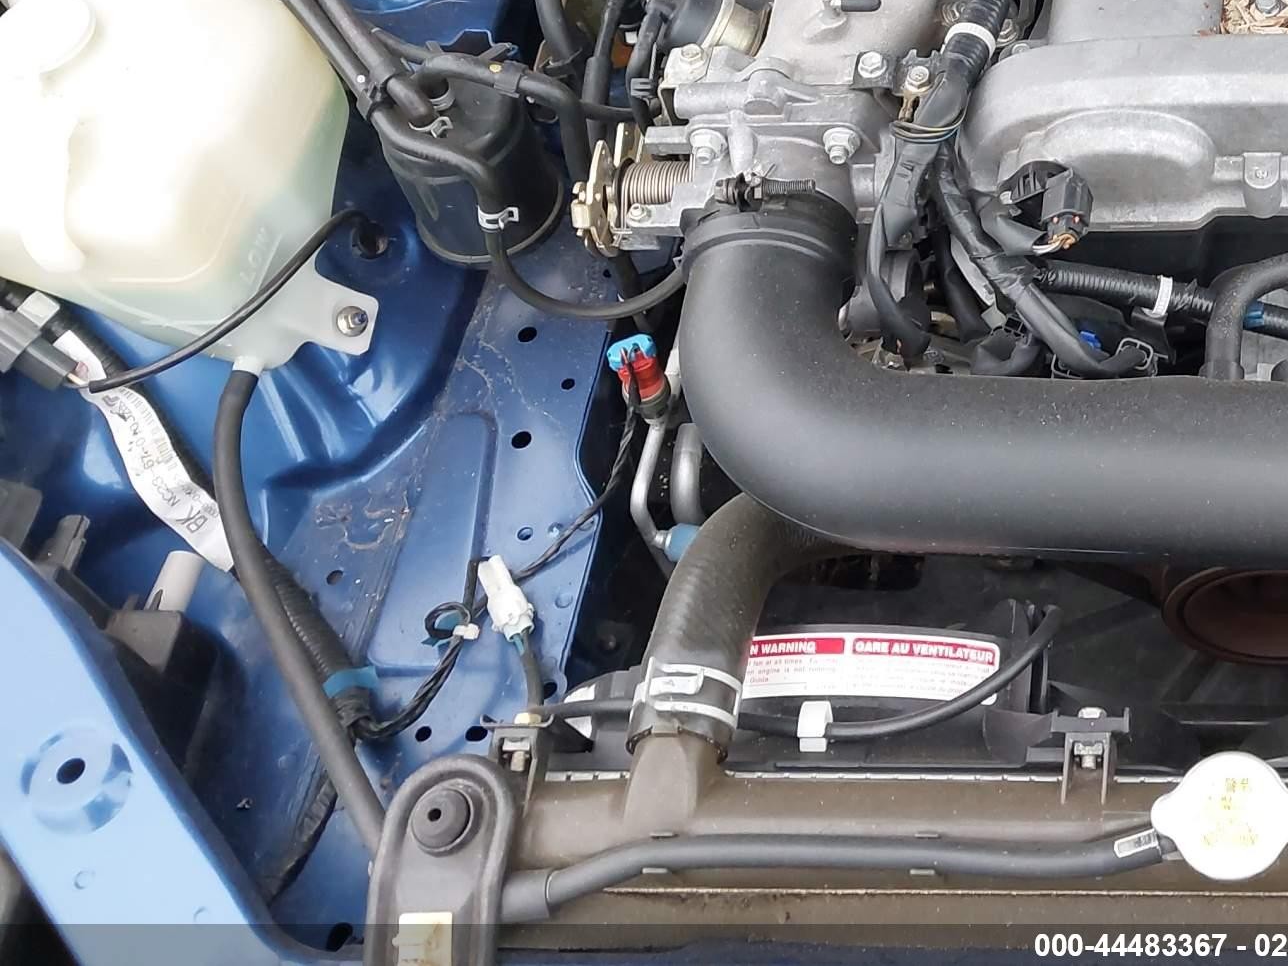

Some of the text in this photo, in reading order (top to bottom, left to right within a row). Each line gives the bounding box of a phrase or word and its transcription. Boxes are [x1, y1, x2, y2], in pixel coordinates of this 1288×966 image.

[175, 505, 209, 534] BK
[761, 640, 817, 654] WARNING
[855, 640, 994, 664] GARE AU VENTILATEUR
